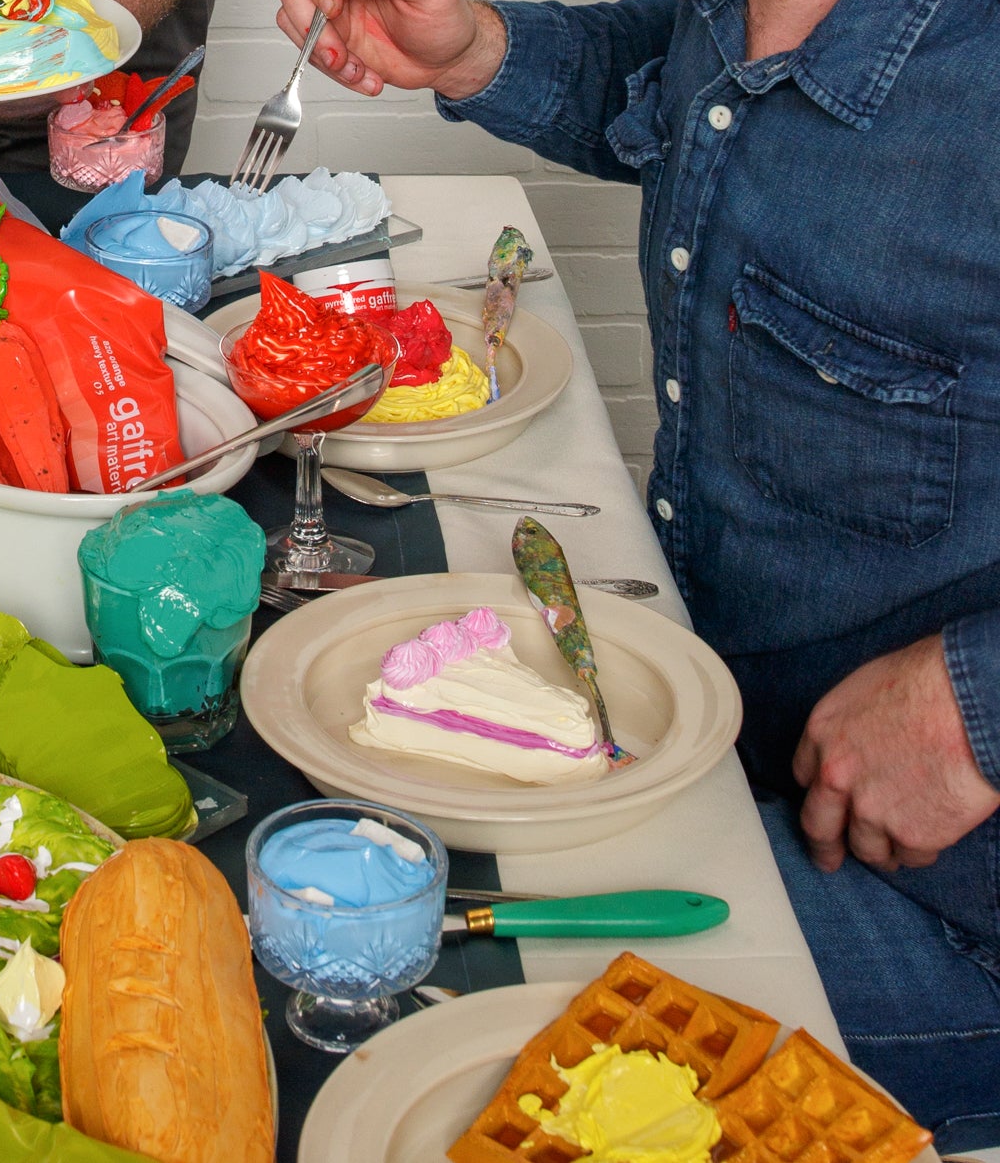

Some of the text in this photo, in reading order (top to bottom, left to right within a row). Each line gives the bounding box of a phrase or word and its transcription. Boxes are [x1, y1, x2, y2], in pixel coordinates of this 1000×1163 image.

[325, 299, 346, 310] pyrro
[89, 335, 115, 391] heavy texture
[109, 355, 126, 387] orange
[106, 421, 124, 494] art materi
